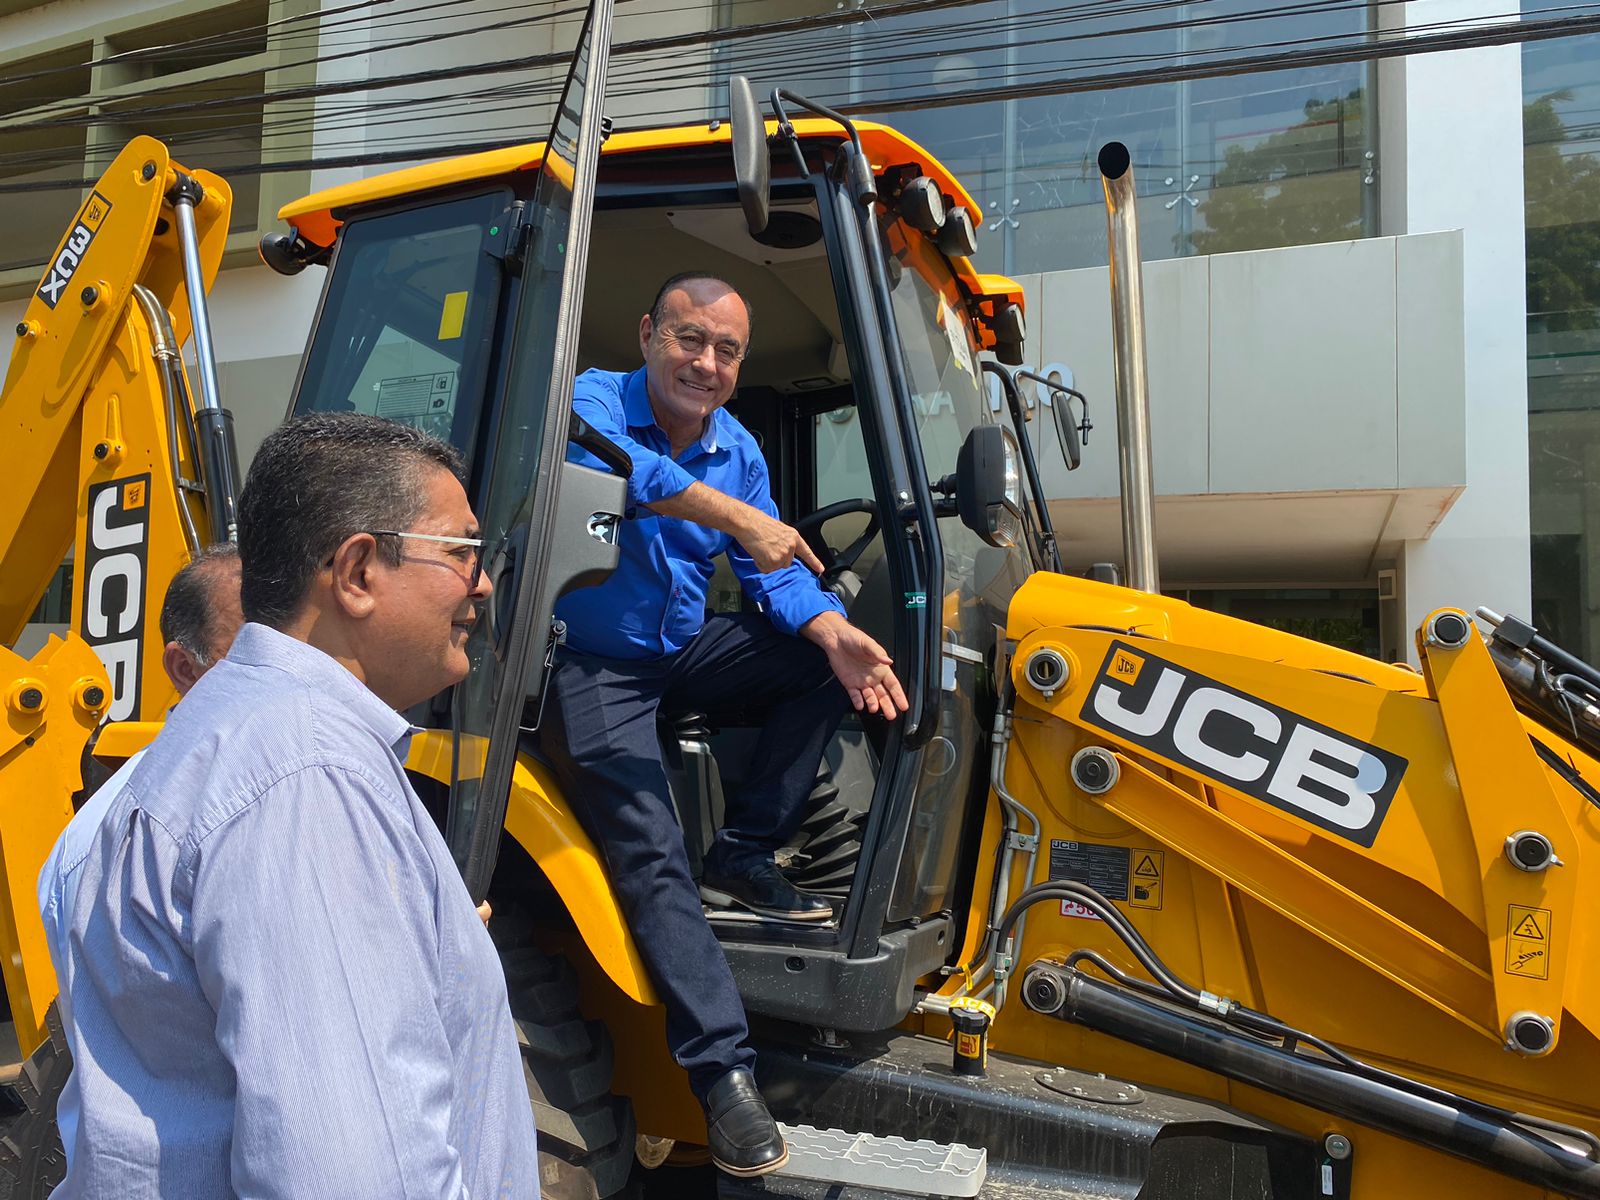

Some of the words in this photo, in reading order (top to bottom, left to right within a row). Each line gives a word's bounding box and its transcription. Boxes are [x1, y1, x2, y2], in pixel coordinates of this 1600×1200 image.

[40, 225, 91, 304] 3CX
[908, 595, 927, 604] JC
[1117, 657, 1135, 674] JCB
[1094, 667, 1388, 830] JCB
[1052, 840, 1079, 850] JCB
